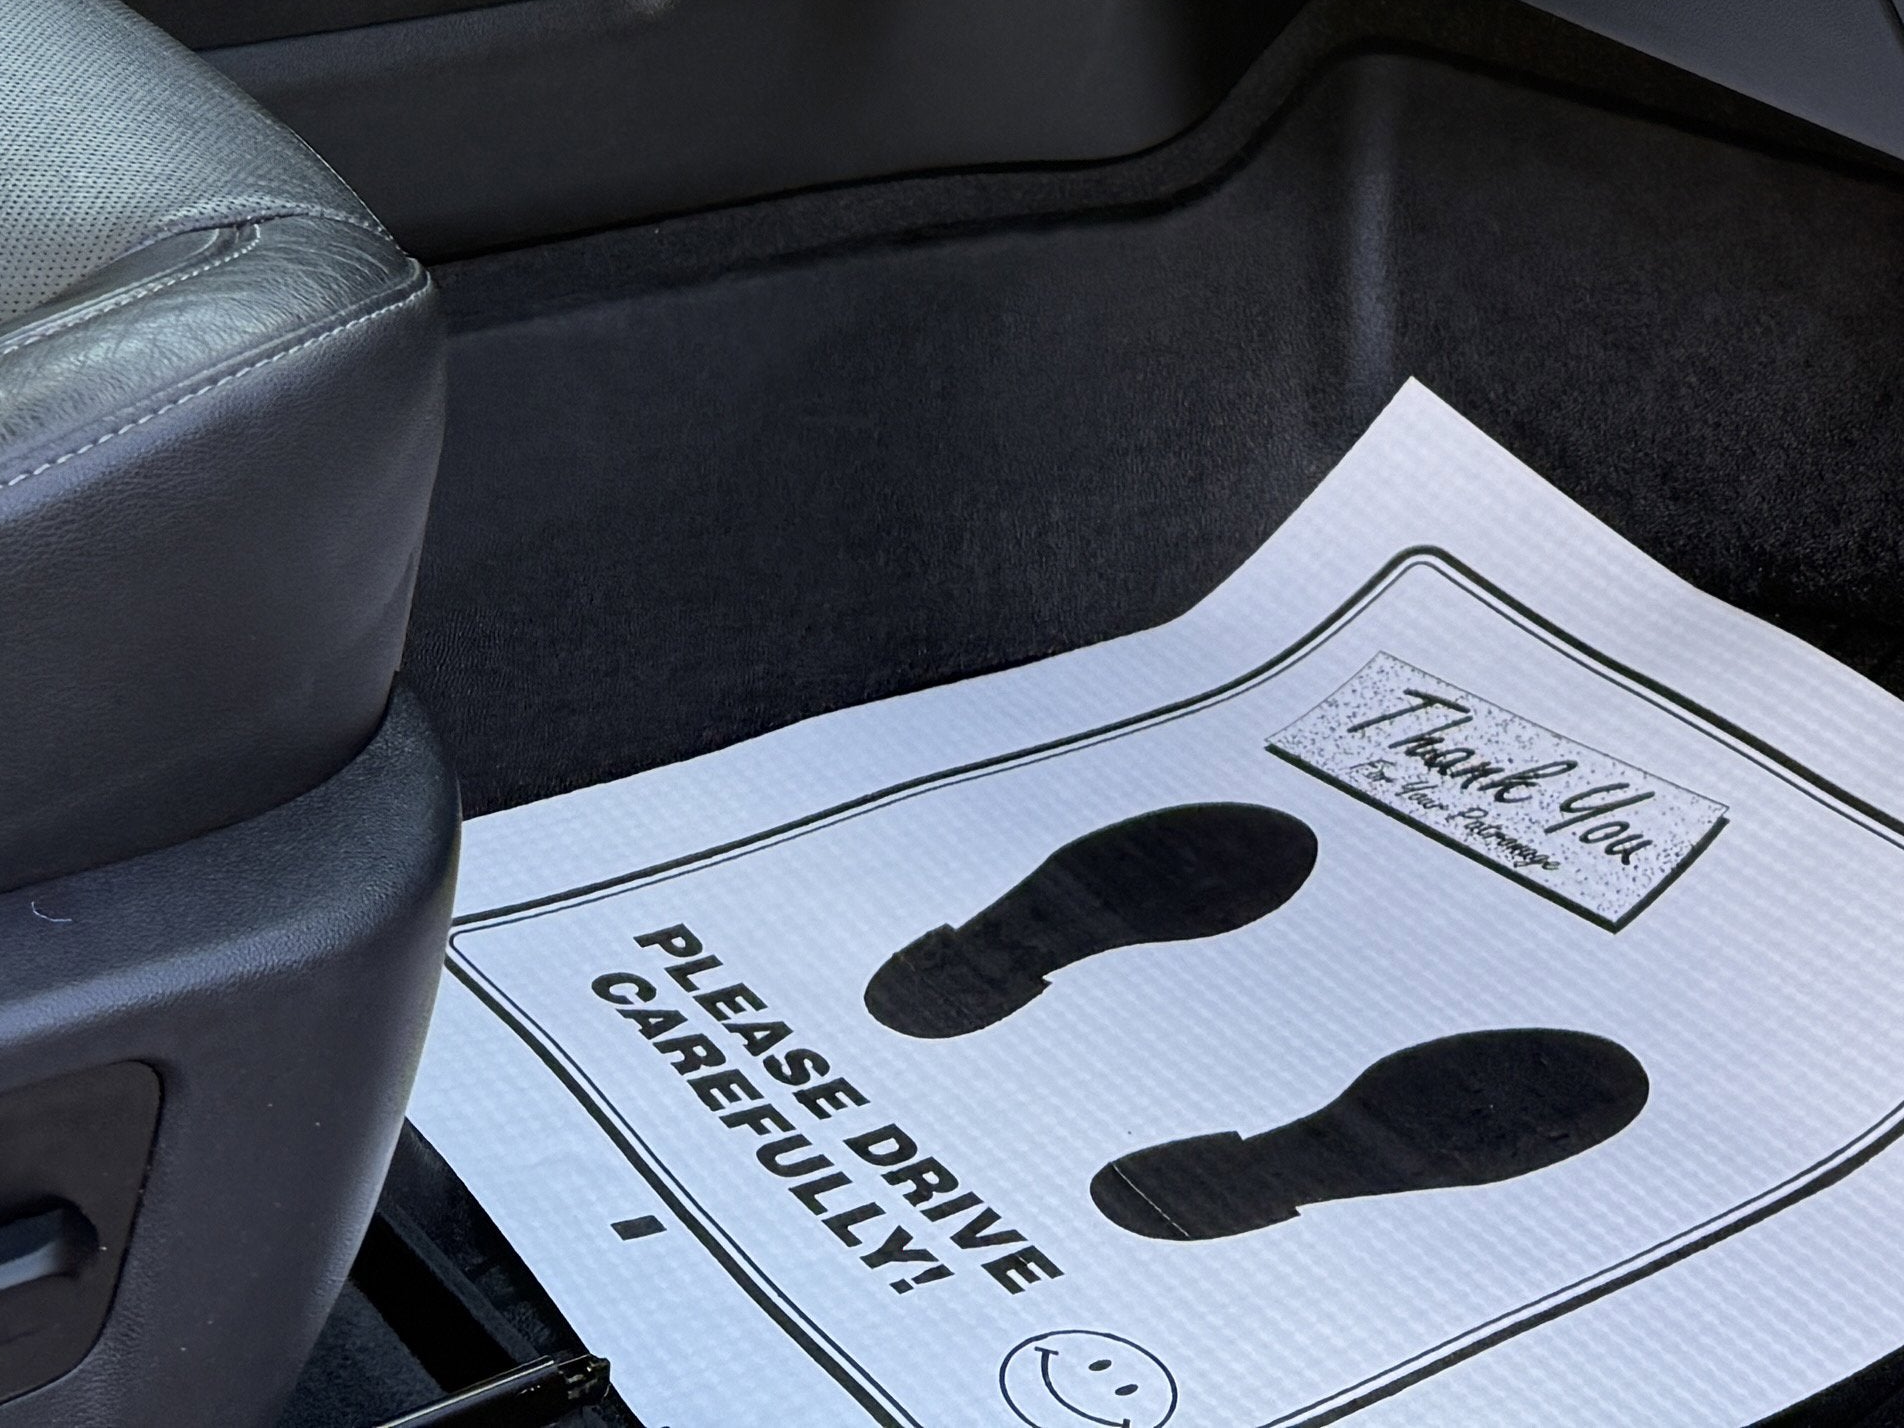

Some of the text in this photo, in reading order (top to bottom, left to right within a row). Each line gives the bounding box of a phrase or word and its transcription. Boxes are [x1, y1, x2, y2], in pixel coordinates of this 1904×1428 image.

[1347, 687, 1656, 866] Thank You
[1348, 758, 1561, 871] For Your Patronage
[590, 971, 955, 1295] CAREFULLY!
[632, 922, 1066, 1295] PLEASE DRIVE
